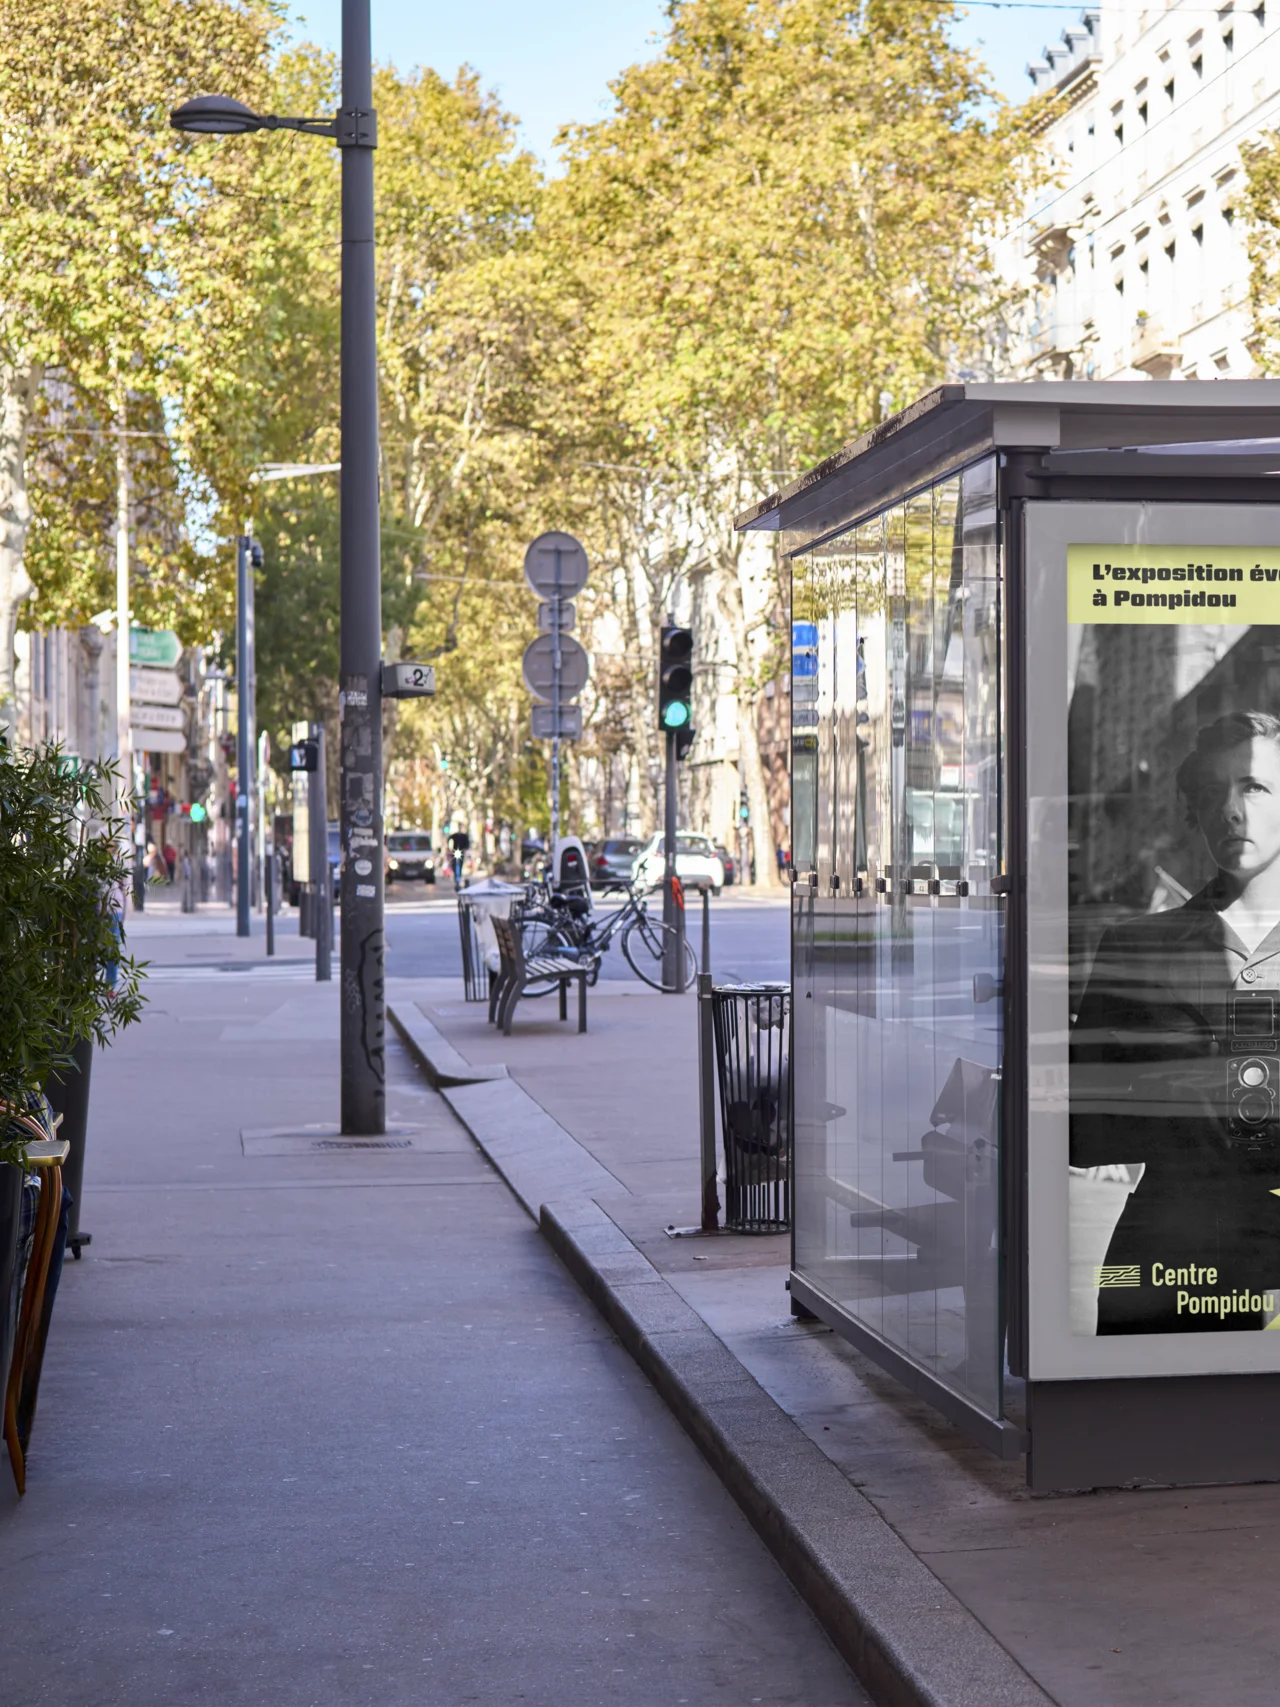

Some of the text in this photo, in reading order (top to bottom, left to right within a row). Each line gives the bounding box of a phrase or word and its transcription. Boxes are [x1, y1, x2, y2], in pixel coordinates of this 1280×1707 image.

[1093, 564, 1243, 583] L'exposition
[1093, 589, 1236, 610] à Pompidou
[1152, 1263, 1217, 1286] Centre
[1177, 1289, 1274, 1319] Pompidou
